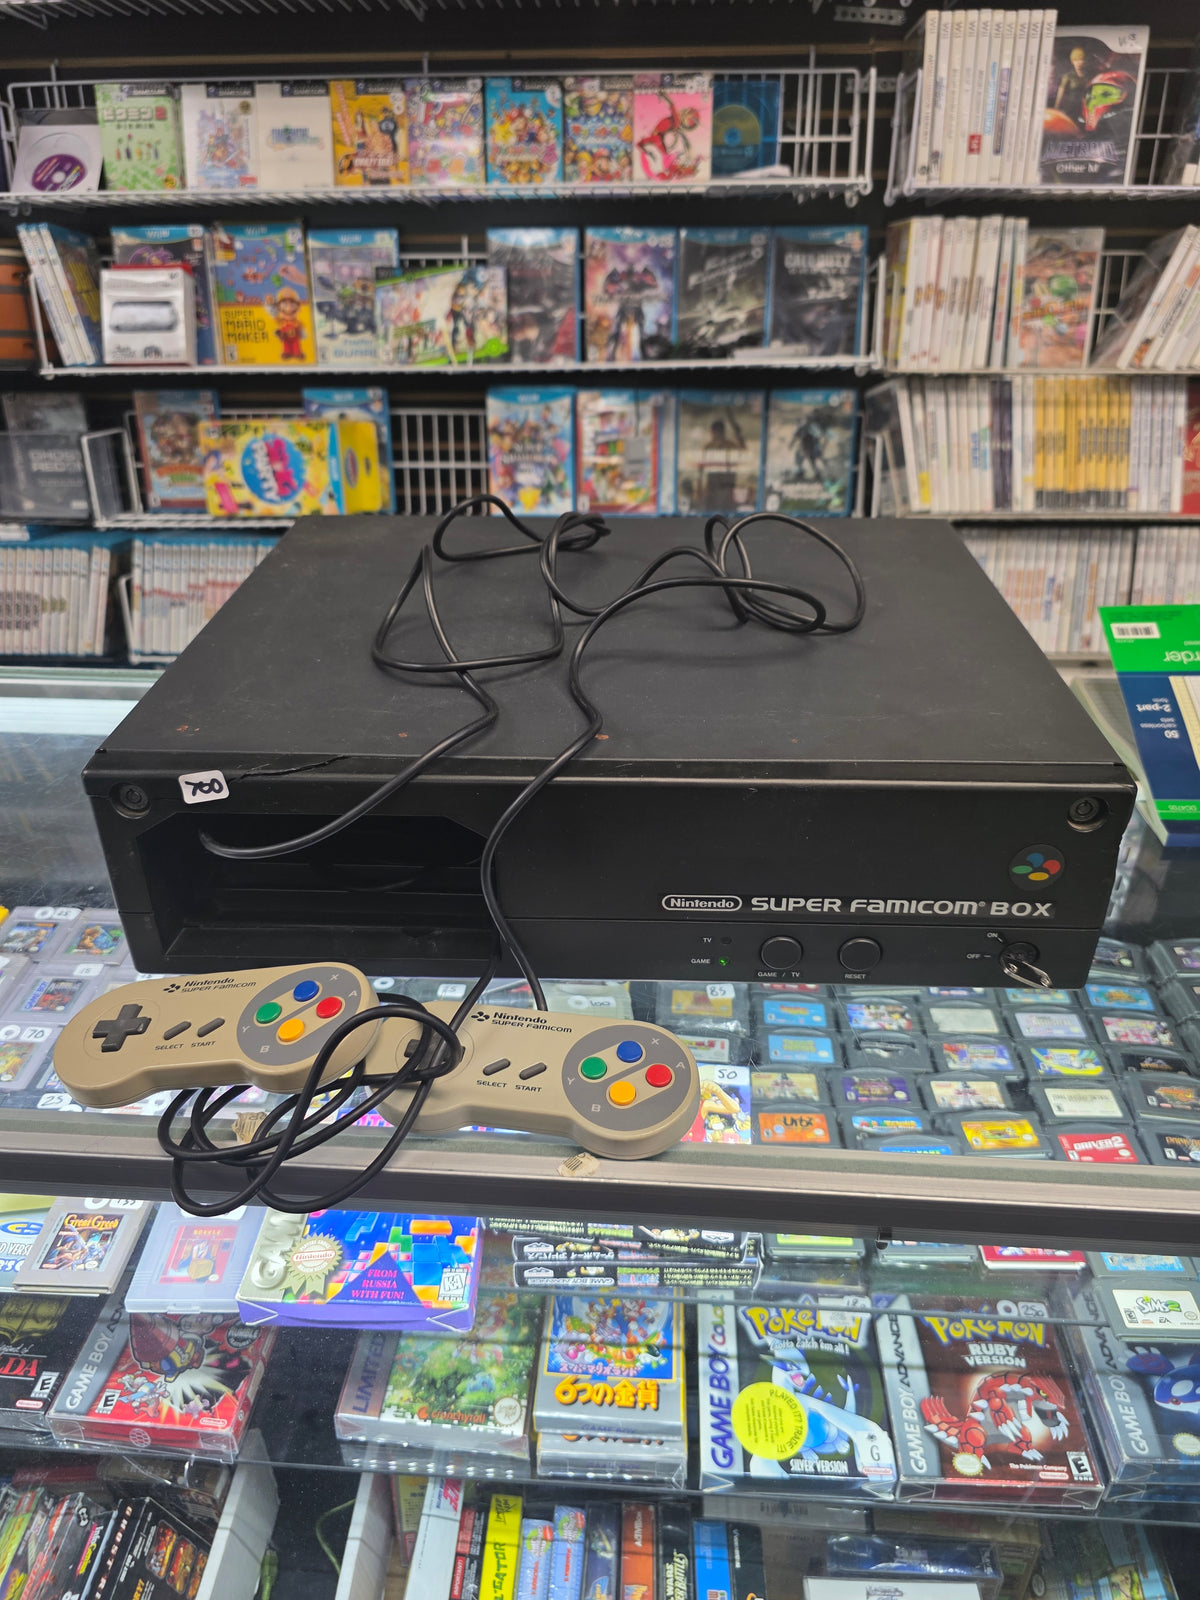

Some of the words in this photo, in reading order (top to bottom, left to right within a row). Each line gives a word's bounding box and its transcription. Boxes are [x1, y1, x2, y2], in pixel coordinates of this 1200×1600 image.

[1164, 729, 1180, 739] 50
[184, 778, 224, 797] 700
[669, 898, 735, 909] Nintendo
[751, 896, 841, 913] SUPER
[989, 901, 1052, 917] BOX
[181, 985, 213, 993] SUPER
[184, 977, 236, 988] Nintendo
[709, 985, 728, 997] 85
[491, 1019, 525, 1029] SUPER
[493, 1012, 548, 1025] Nintendo
[154, 1043, 185, 1052] SELECT
[190, 1040, 217, 1049] START
[717, 1068, 738, 1080] 50
[476, 1079, 508, 1089] SELECT
[514, 1084, 543, 1094] START
[1072, 1138, 1113, 1151] DRIVER
[1111, 1136, 1127, 1148] 2
[8, 1242, 33, 1256] VERSI
[367, 1269, 398, 1279] FROM
[362, 1279, 399, 1289] RUSSIA
[351, 1290, 379, 1299] WITH
[380, 1291, 405, 1300] FUN!
[967, 1342, 1018, 1357] RUBY
[709, 1345, 731, 1392] BOY
[962, 1354, 1026, 1368] VERSION
[66, 1363, 98, 1410] GAME
[88, 1332, 114, 1364] BOY
[554, 1375, 659, 1411] 6つの金貨
[1109, 1371, 1132, 1401] BOY
[769, 1389, 798, 1410] PLAYED
[899, 1387, 916, 1418] BOY
[709, 1393, 733, 1469] GAME
[1121, 1403, 1149, 1455] GAME
[904, 1416, 927, 1473] GAME
[870, 1445, 881, 1462] G
[789, 1459, 815, 1473] SILVER
[815, 1459, 849, 1475] VERSION
[1043, 1464, 1068, 1472] Company
